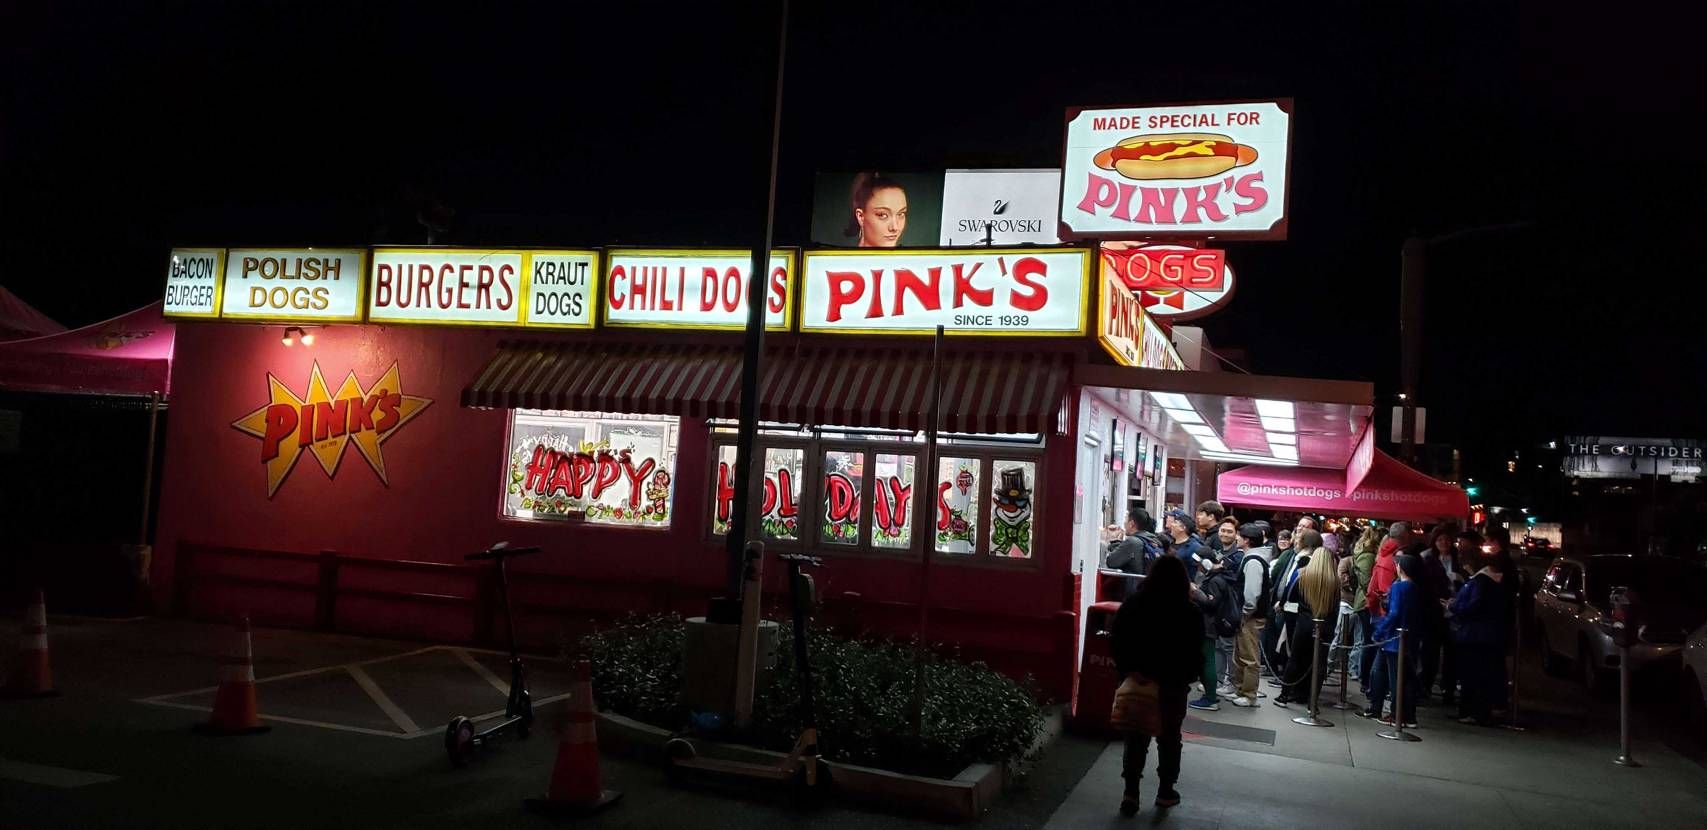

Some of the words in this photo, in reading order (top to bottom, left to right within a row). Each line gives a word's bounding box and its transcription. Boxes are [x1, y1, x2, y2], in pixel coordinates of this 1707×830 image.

[1093, 116, 1141, 131] MADE
[1148, 113, 1220, 129] SPECIAL
[1227, 111, 1260, 126] FOR
[1077, 170, 1269, 225] PINK'S
[958, 219, 1042, 233] SWAROVSKI
[171, 257, 214, 279] BACON
[241, 256, 341, 281] POLISH
[534, 260, 588, 286] KRAUT
[166, 285, 214, 307] BURGER
[248, 286, 330, 311] DOGS
[375, 262, 515, 311] BURGERS
[608, 264, 686, 312] CHILI
[699, 265, 787, 314] DOS
[825, 256, 1049, 323] PINK'S
[534, 291, 583, 317] DOGS
[953, 314, 993, 326] SINCE
[998, 314, 1030, 326] 1939
[261, 388, 402, 464] PINK'S
[1569, 444, 1600, 455] THE
[1610, 445, 1703, 458] OUTSIDER
[525, 443, 656, 511] HAPPY
[1237, 482, 1341, 500] @pinkshotdogs
